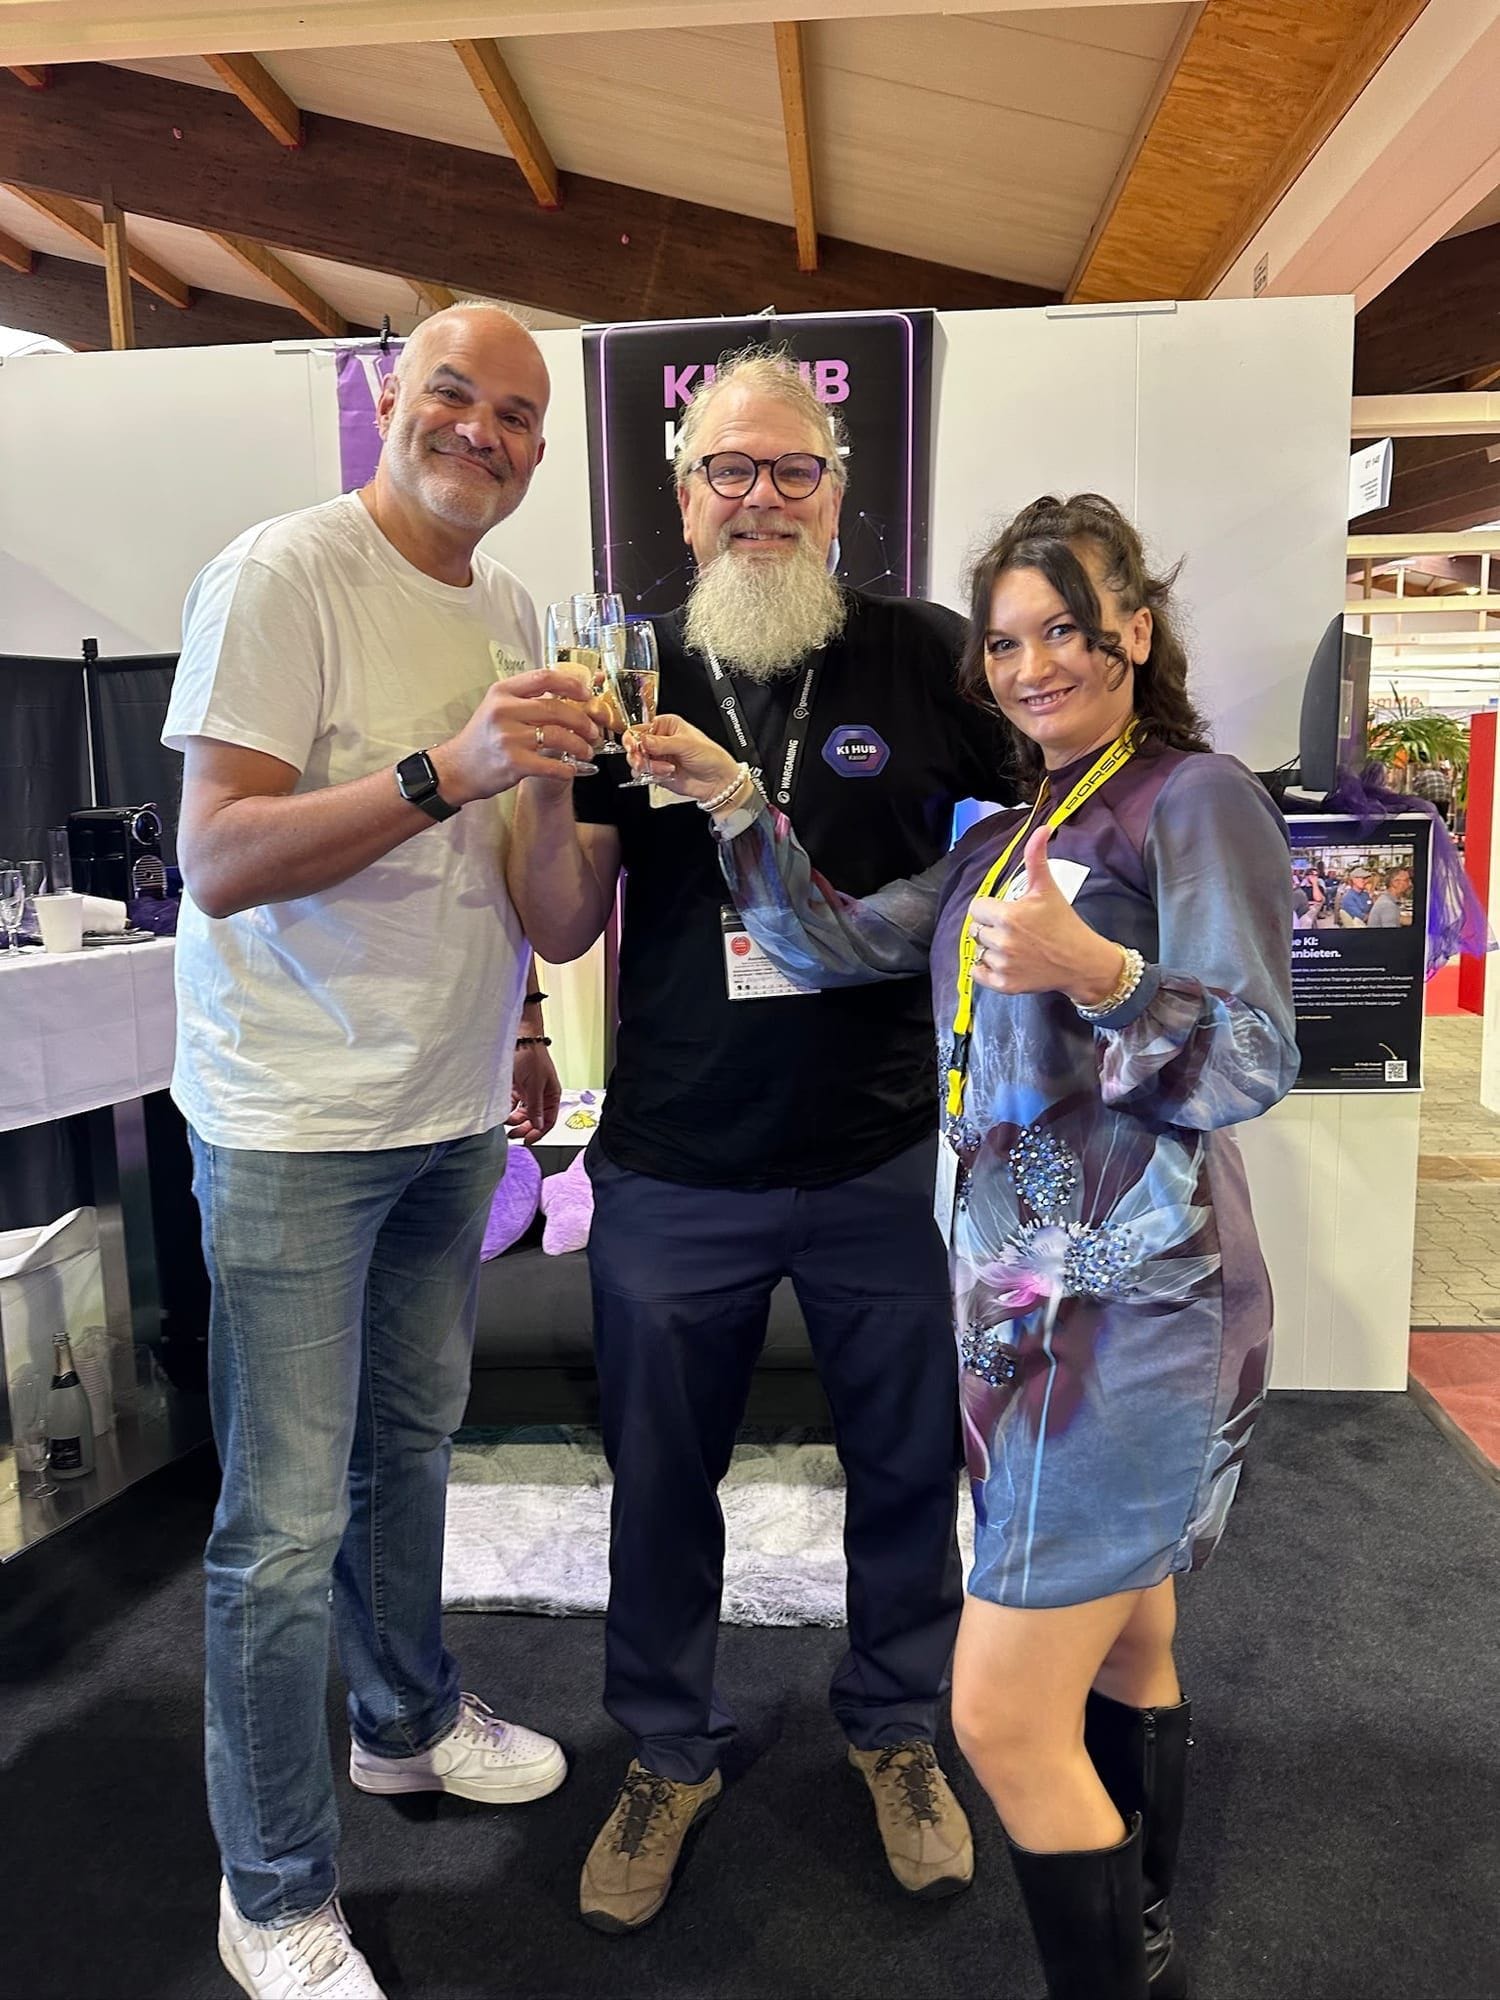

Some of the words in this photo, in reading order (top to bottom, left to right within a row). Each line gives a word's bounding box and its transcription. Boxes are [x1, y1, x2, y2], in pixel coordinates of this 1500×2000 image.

[726, 708, 748, 748] gamescom
[836, 745, 850, 756] KI
[851, 744, 878, 755] HUB
[780, 739, 799, 790] WARGAMING
[1303, 936, 1319, 946] KI:
